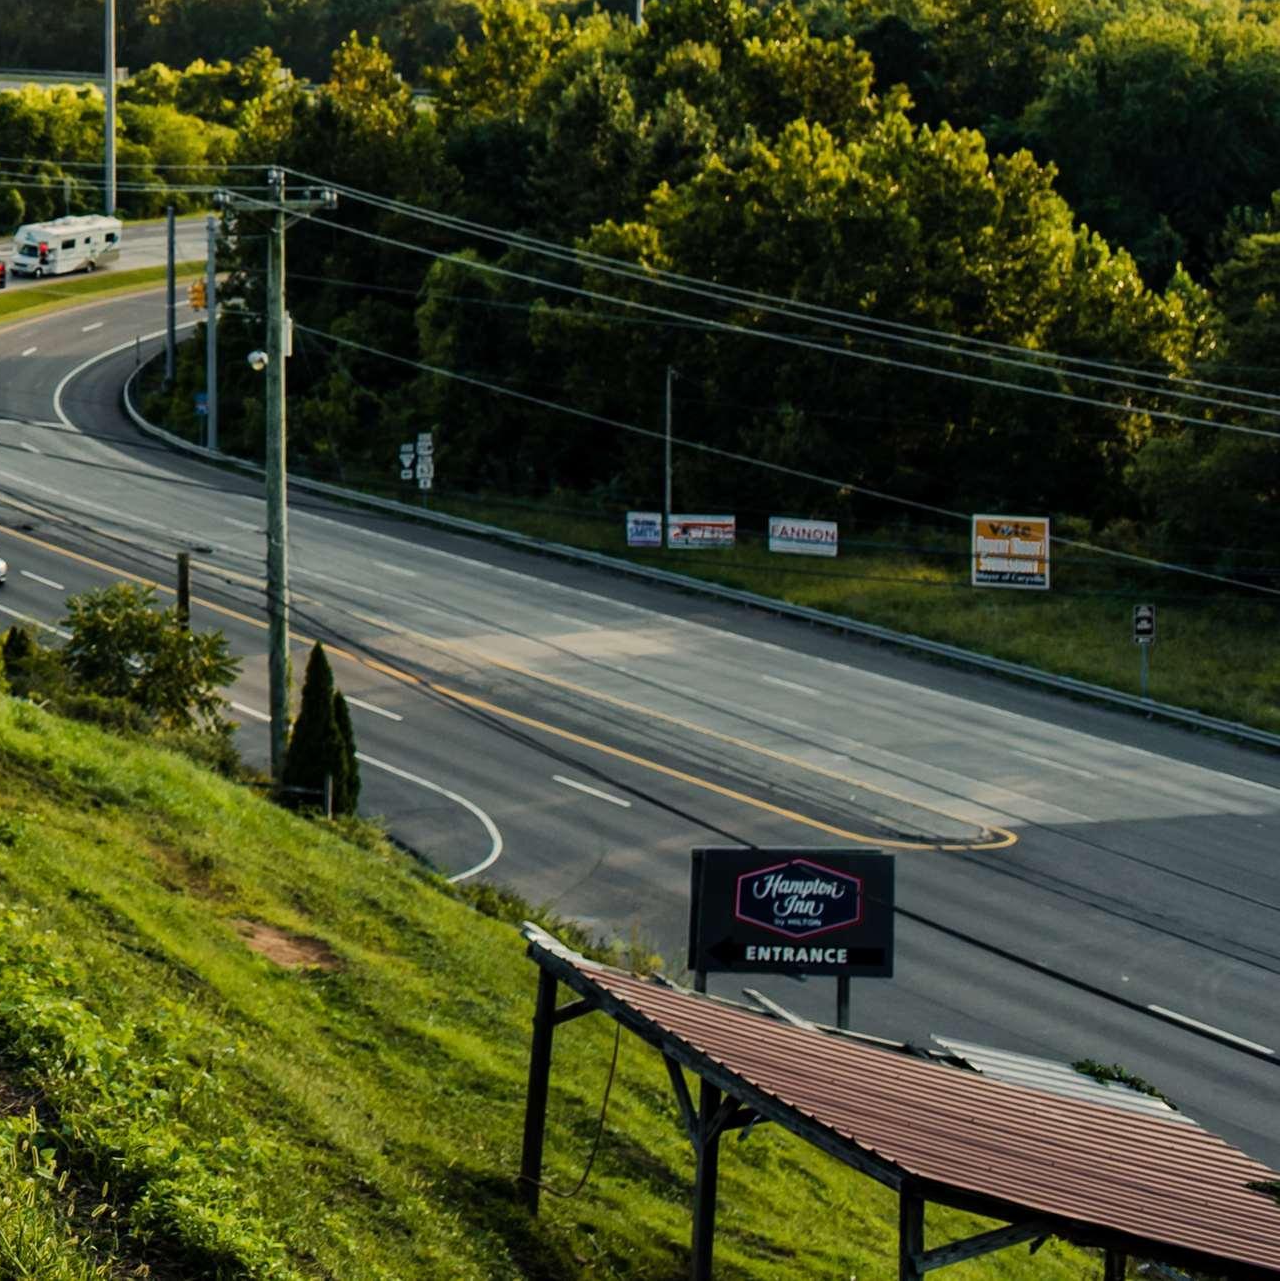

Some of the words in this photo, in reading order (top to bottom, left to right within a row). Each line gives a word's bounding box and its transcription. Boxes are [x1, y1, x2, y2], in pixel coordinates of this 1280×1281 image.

[989, 522, 1031, 536] Vote
[753, 873, 846, 900] Hampton
[773, 895, 825, 917] Inn
[774, 918, 785, 926] by
[787, 918, 822, 926] HILTON
[746, 946, 847, 964] ENTRANCE
